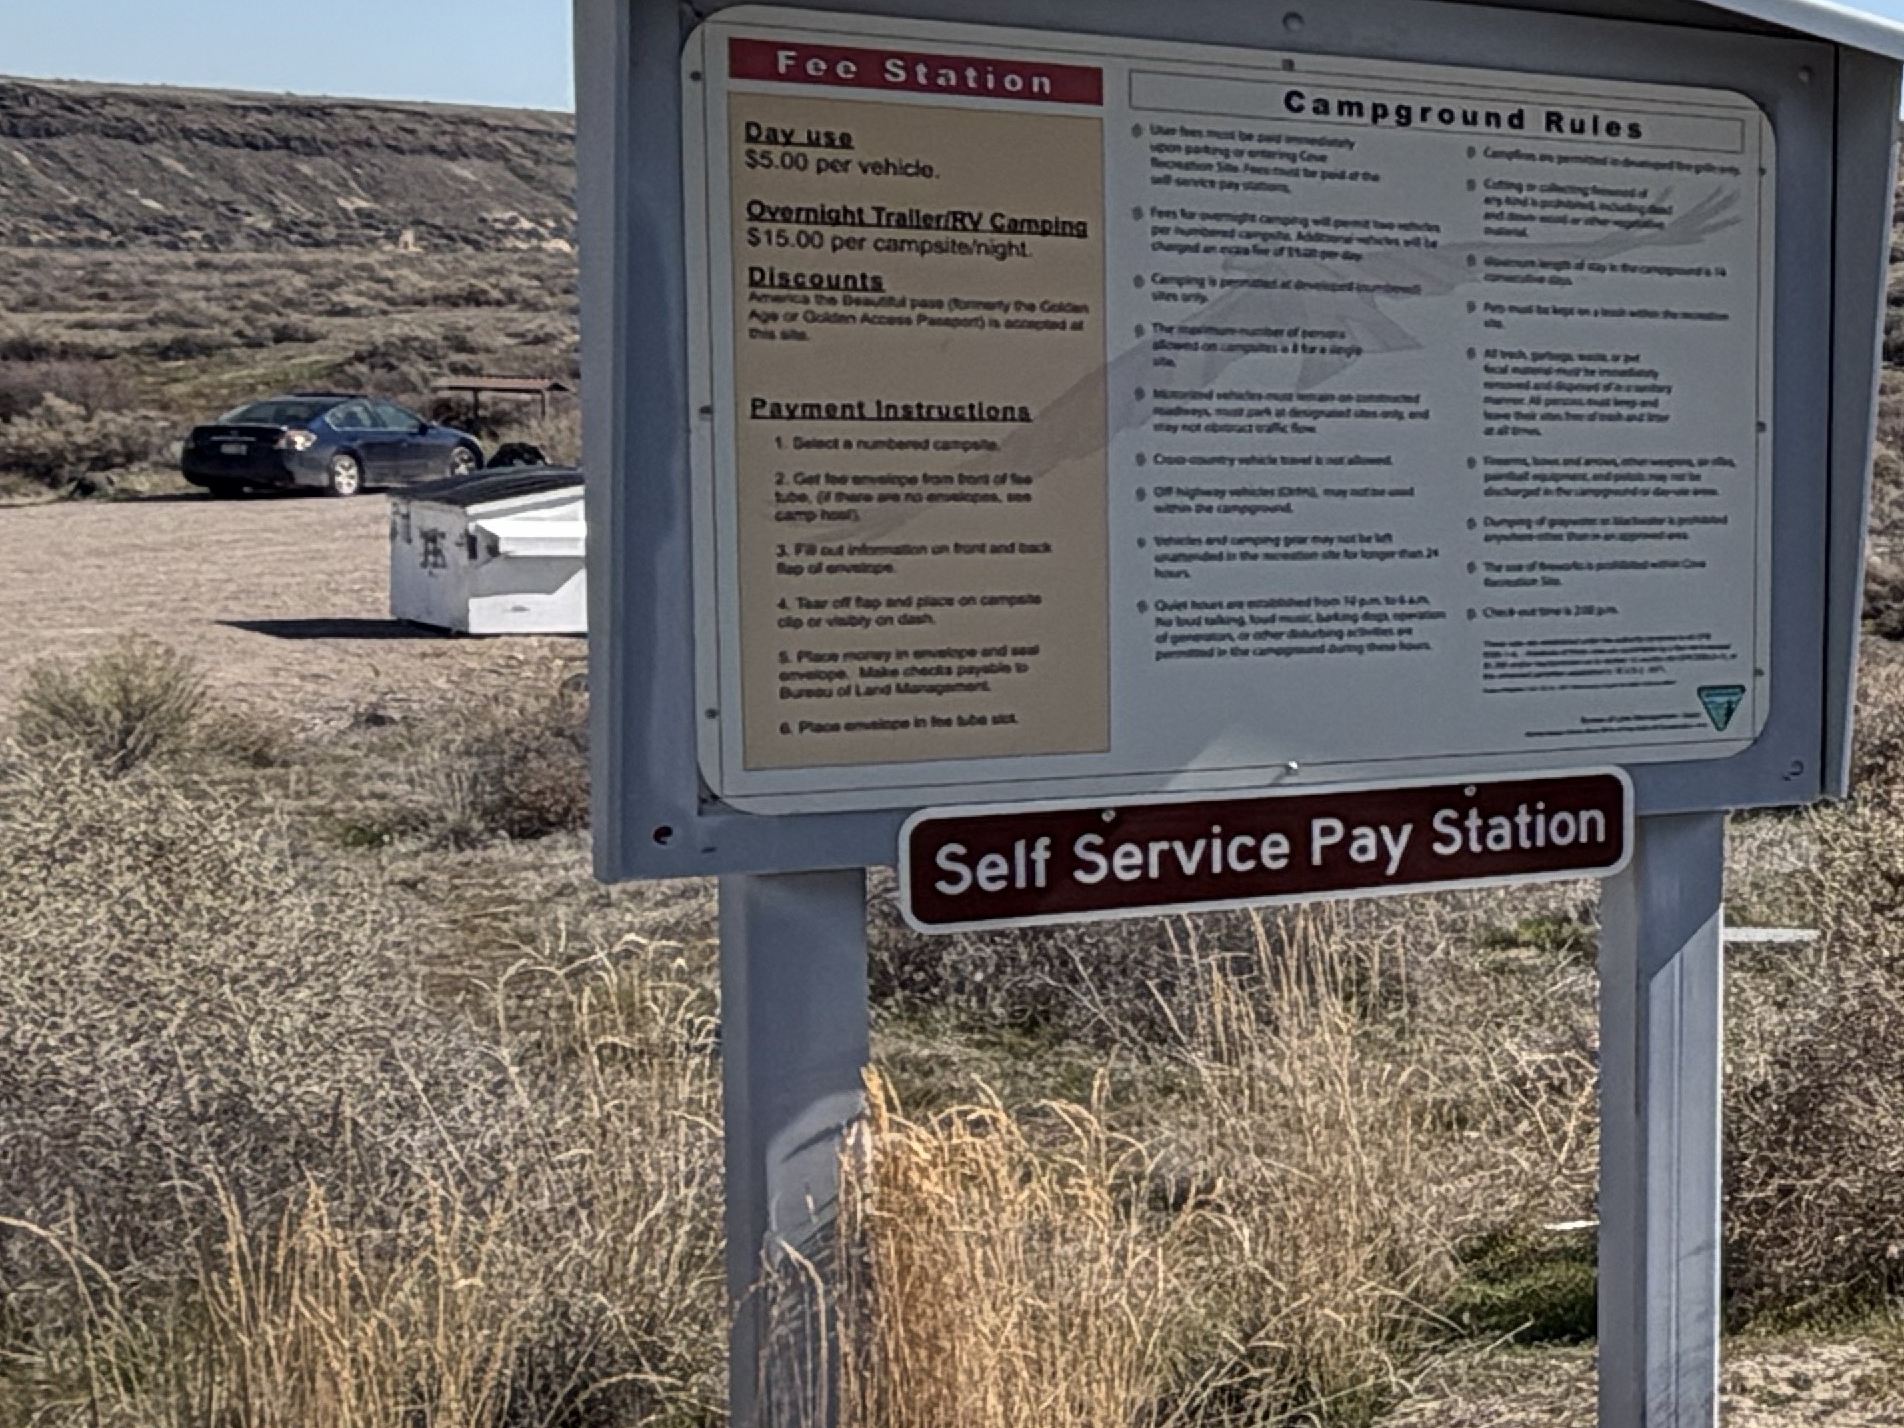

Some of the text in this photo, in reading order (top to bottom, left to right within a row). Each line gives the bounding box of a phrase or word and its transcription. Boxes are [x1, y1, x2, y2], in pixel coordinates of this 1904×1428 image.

[776, 49, 1052, 96] Fee Station
[1284, 89, 1644, 140] Campground Rules
[744, 121, 853, 149] Day use
[744, 148, 940, 180] $5.00 per vehicle.
[745, 199, 1088, 238] Overnight Trailer/RV Camping
[746, 228, 1032, 262] $15.00 per campsite/night.
[748, 267, 886, 293] Discounts
[750, 398, 1033, 423] Payment Instructions
[934, 799, 1608, 897] Self Service Pay Station
